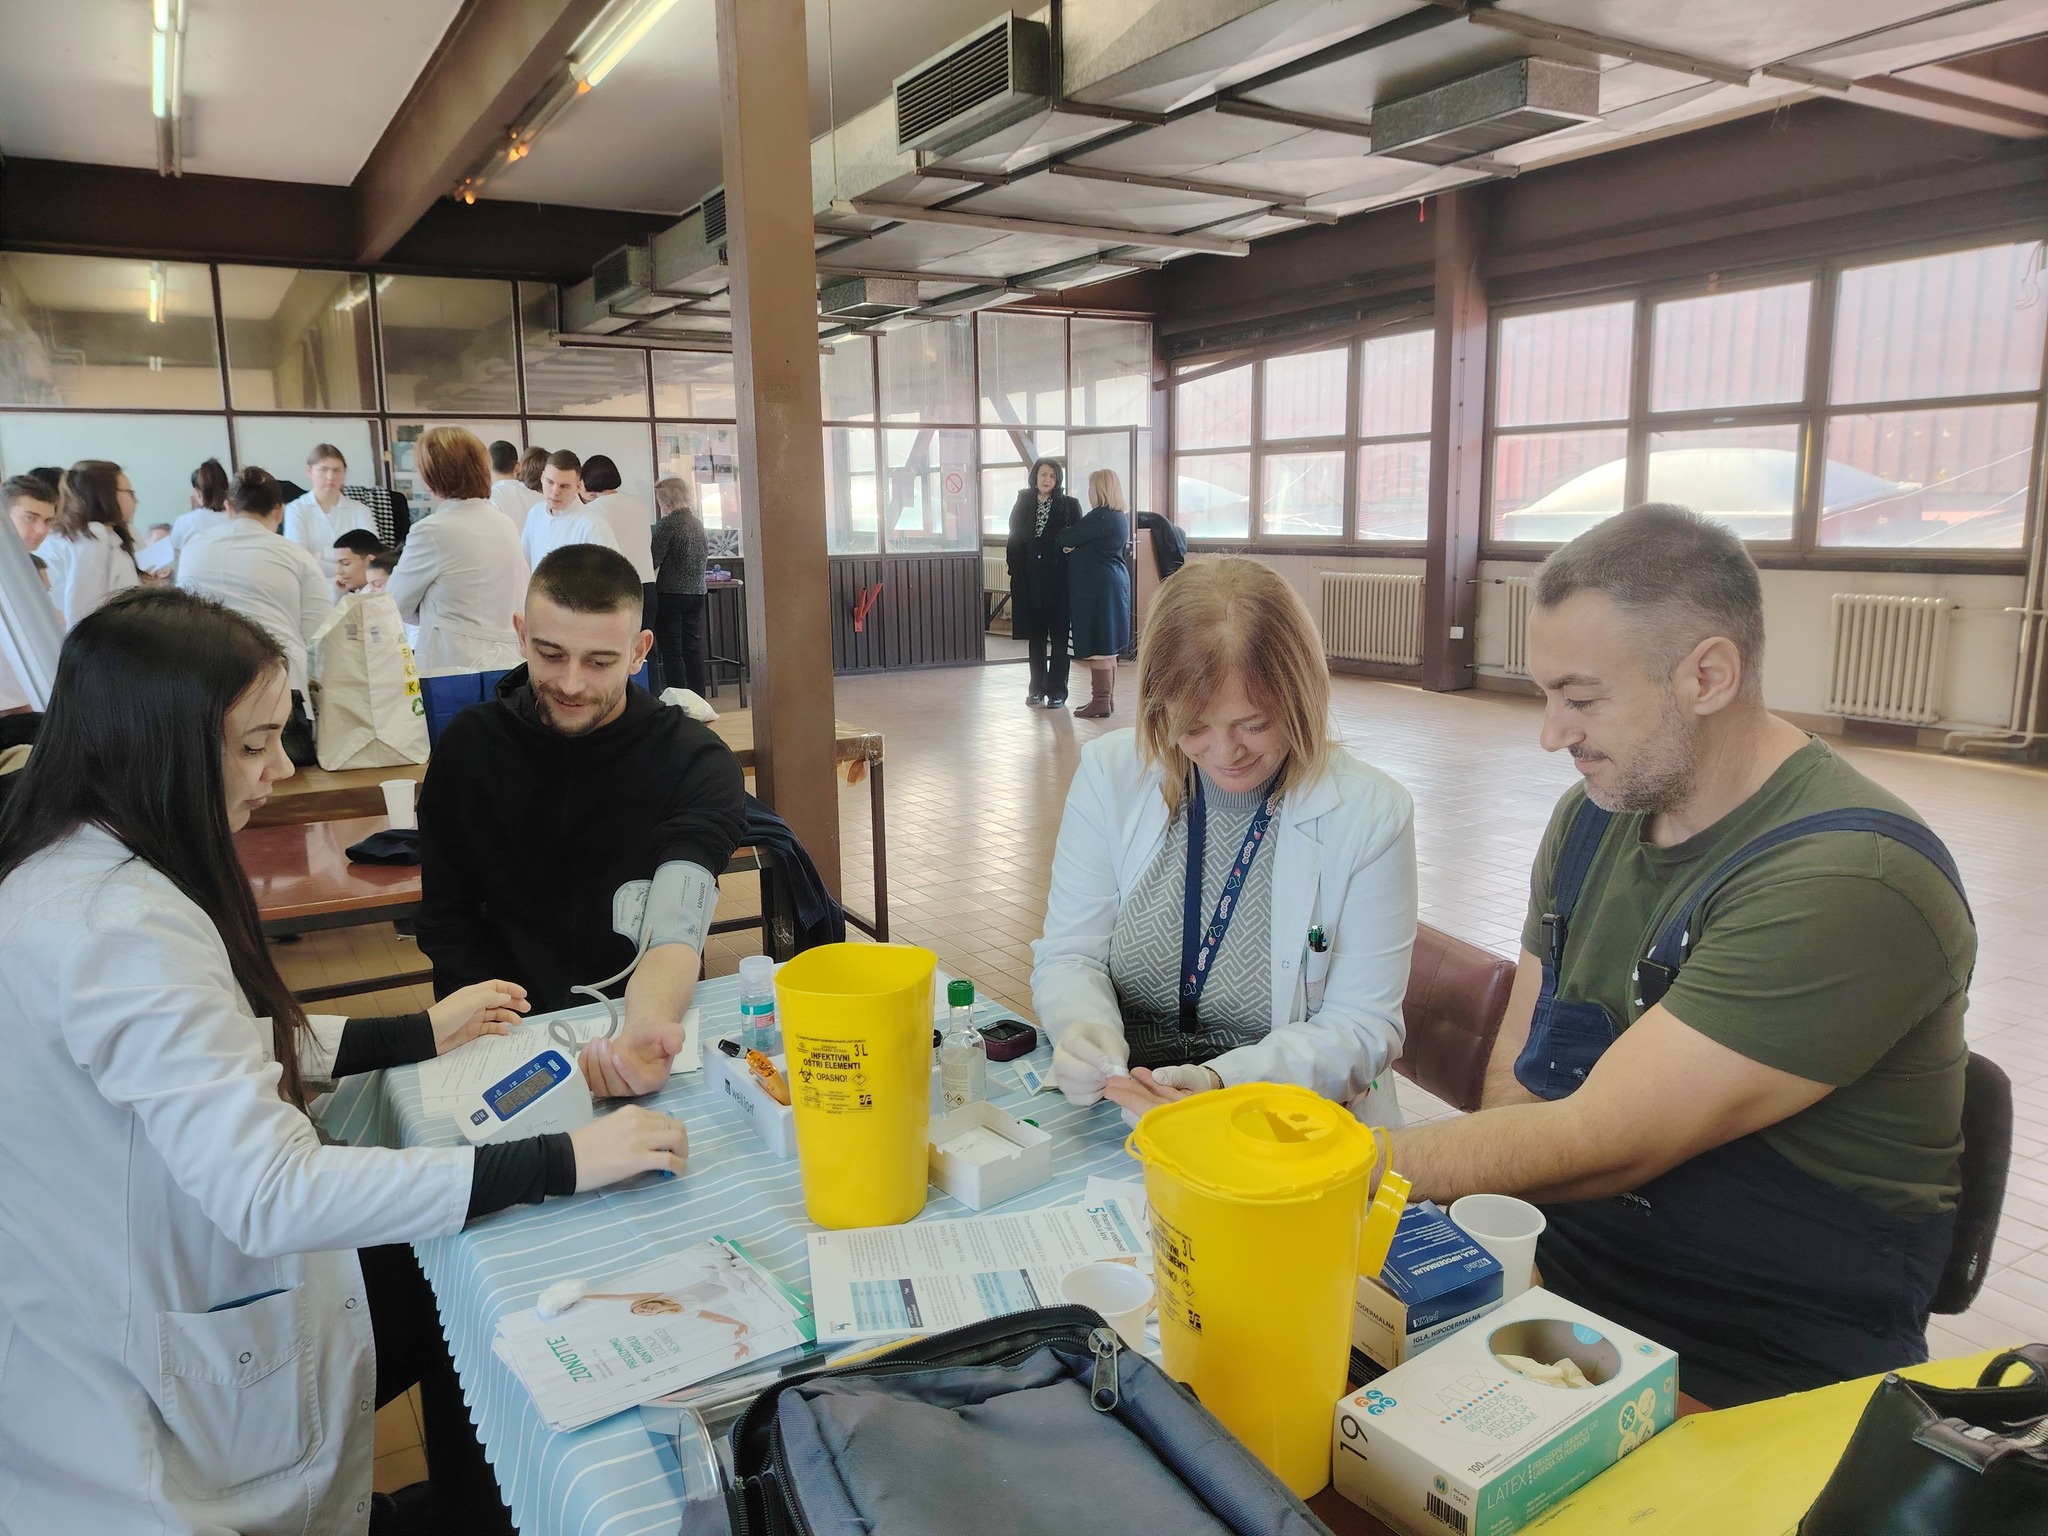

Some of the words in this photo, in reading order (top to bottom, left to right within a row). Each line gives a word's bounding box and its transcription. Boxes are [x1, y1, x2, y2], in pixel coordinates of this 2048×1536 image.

[803, 1058, 823, 1068] OŠTRI
[824, 1062, 861, 1070] ELEMENTI
[811, 1052, 850, 1062] INFEKTIVNI
[853, 1044, 860, 1057] 3
[861, 1044, 868, 1057] L
[816, 1072, 848, 1082] OPASNO!
[1431, 1313, 1482, 1337] HIPODERMALNA
[546, 1335, 593, 1383] ZONOTTE
[608, 1337, 641, 1370] PREUZMIMO
[625, 1335, 655, 1365] KONTROLU
[1417, 1368, 1497, 1417] LATEX
[1460, 1391, 1510, 1422] PREGLEDNE
[1465, 1403, 1510, 1432] RUKAVICE
[1506, 1395, 1524, 1407] OD
[1480, 1412, 1520, 1436] LATEKSA
[1514, 1404, 1532, 1415] SA
[1494, 1411, 1540, 1442] PUDEROM
[1339, 1414, 1369, 1462] 19
[1467, 1461, 1486, 1475] 100
[1487, 1470, 1527, 1510] LATEX
